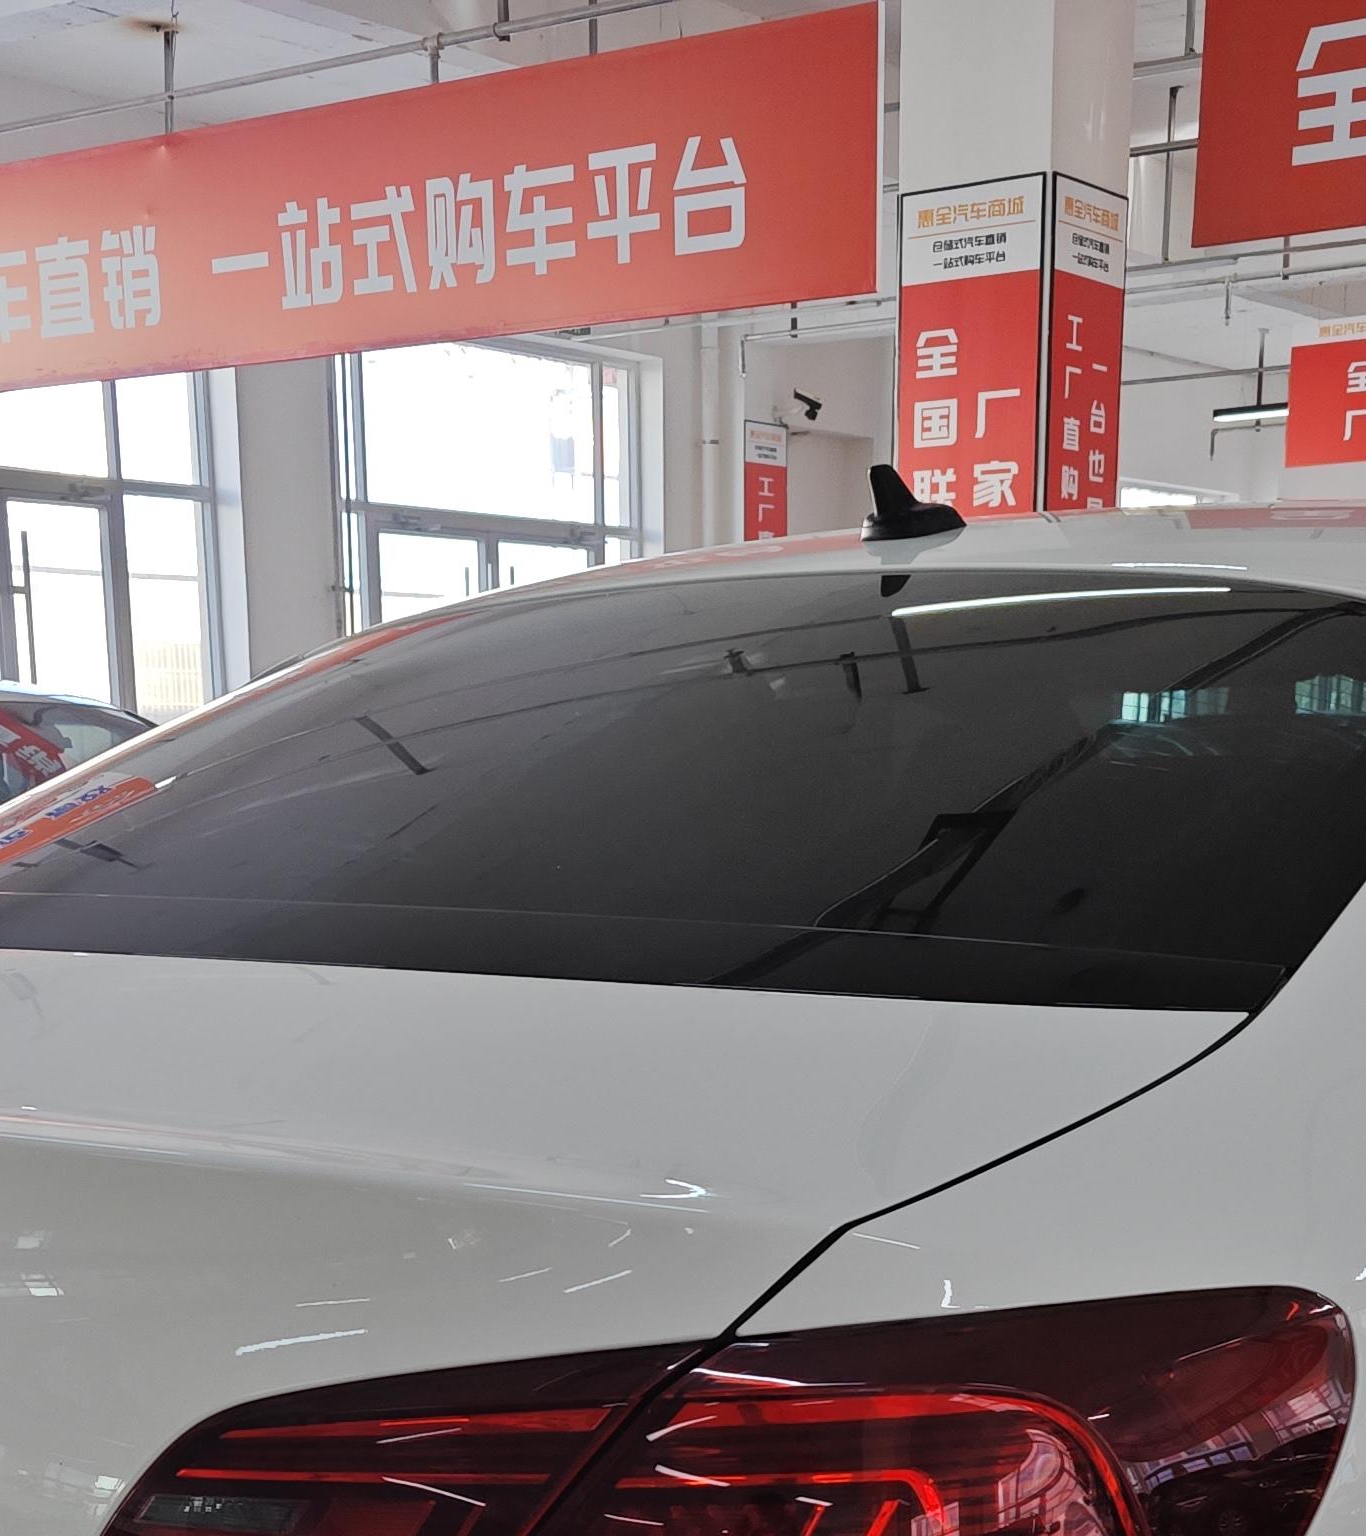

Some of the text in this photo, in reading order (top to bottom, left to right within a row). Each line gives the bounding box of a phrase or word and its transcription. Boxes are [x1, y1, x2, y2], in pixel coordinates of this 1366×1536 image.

[211, 136, 747, 310] 一站式购车平台
[917, 195, 1025, 229] 惠全汽车商城
[932, 250, 1006, 270] 一站式购车平台
[1061, 314, 1083, 501] 工厂直购
